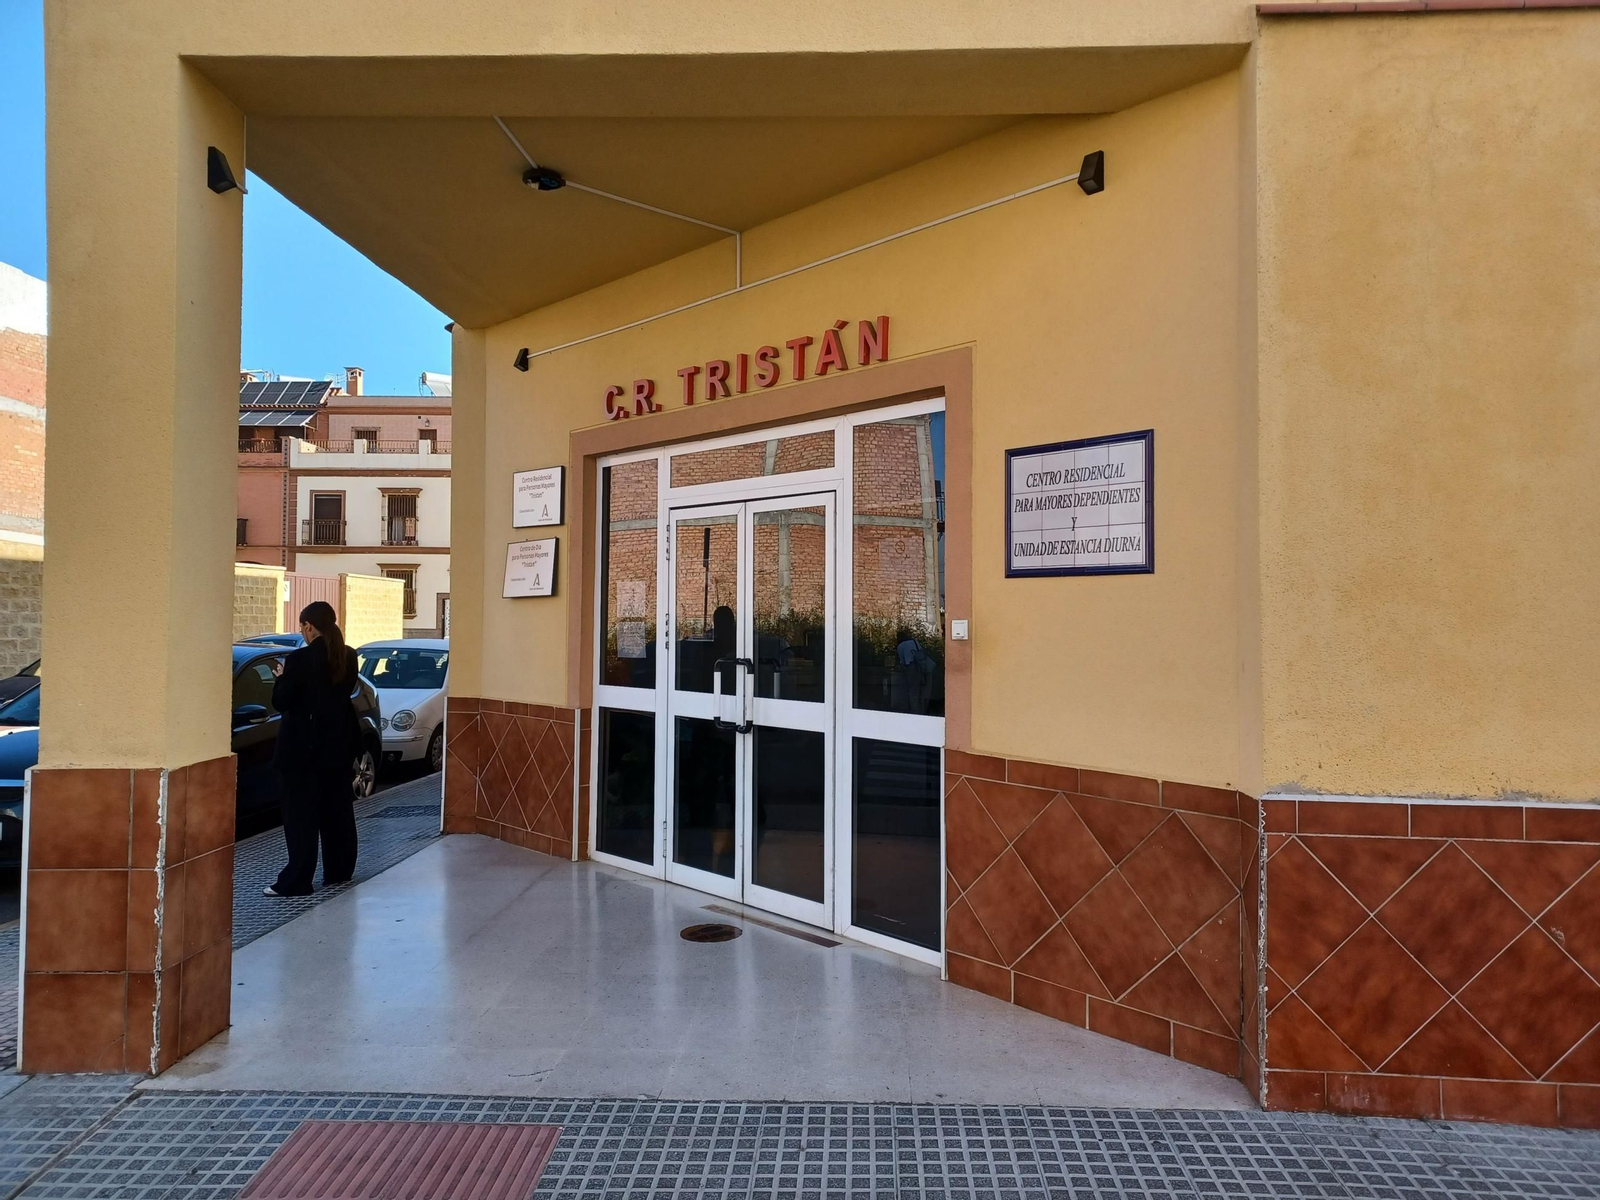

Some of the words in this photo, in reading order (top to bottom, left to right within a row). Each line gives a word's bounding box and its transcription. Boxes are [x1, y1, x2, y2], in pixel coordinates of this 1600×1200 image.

[603, 379, 662, 420] C.R.
[677, 315, 890, 405] TRISTÁN
[1026, 470, 1062, 488] CENTRO
[1063, 462, 1125, 484] RESIDENCIAL
[1014, 497, 1034, 513] PARA
[1034, 493, 1073, 511] MAYORES
[1074, 487, 1141, 508] DEPENDIENTES
[1071, 516, 1078, 531] Y
[1014, 541, 1047, 557] UNIDAD
[1047, 540, 1060, 556] DE
[1059, 537, 1102, 555] ESTANCIA
[1103, 536, 1141, 553] DIURNA
